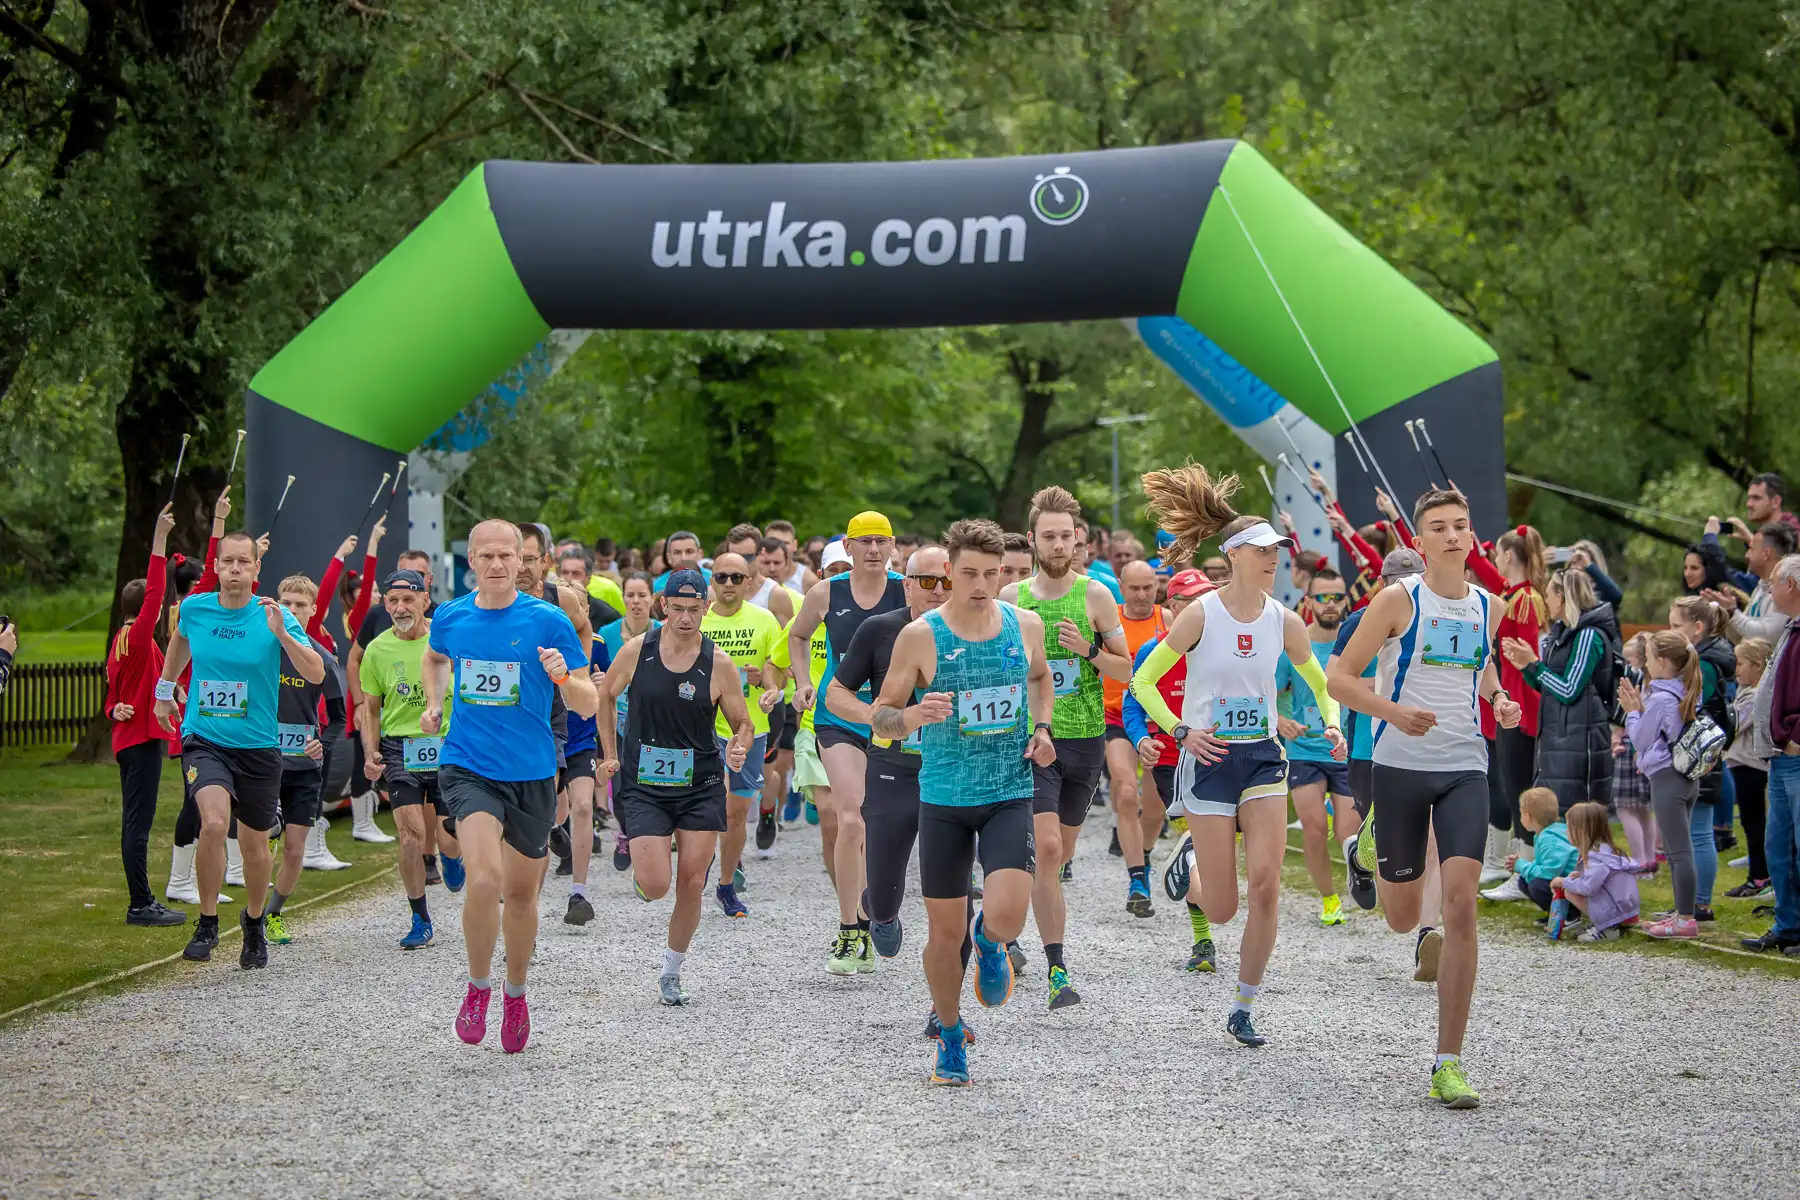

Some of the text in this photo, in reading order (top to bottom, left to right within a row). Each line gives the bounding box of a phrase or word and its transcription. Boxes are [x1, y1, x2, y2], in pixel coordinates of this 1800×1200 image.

[651, 201, 1027, 268] utrka.com
[220, 627, 246, 636] ZRINSKI
[703, 629, 755, 640] RIZMA V&V
[811, 641, 827, 650] PRI
[1450, 634, 1459, 654] 1
[475, 673, 501, 693] 29
[1053, 671, 1065, 688] 9
[207, 691, 236, 707] 121
[972, 700, 1013, 722] 112
[1224, 709, 1259, 728] 195
[277, 732, 305, 747] 179
[417, 747, 438, 762] 69
[653, 759, 676, 776] 21
